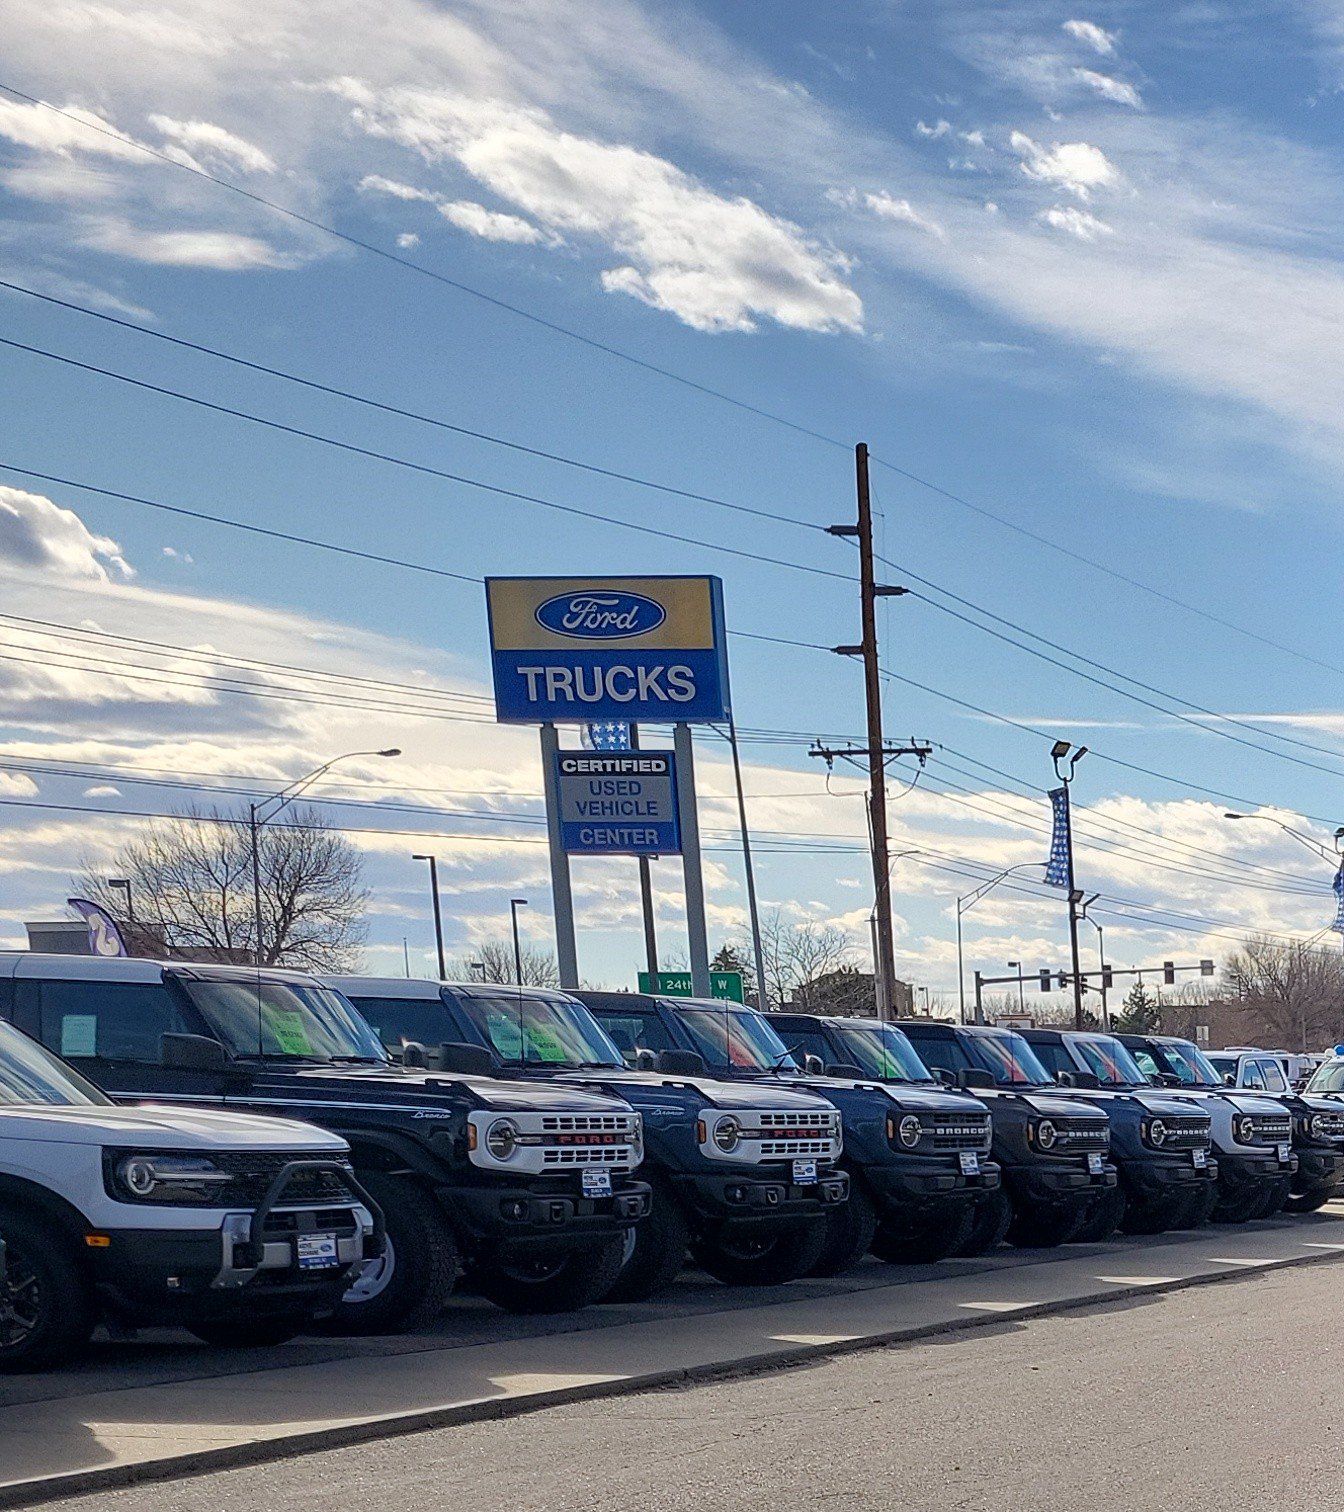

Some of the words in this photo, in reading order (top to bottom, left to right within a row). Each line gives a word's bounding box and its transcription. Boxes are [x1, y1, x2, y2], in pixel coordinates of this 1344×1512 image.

[562, 597, 639, 629] Ford
[517, 665, 697, 702] TRUCKS
[562, 759, 667, 773] CERTIFIED
[589, 780, 642, 796] USED
[576, 801, 659, 817] VEHICLE
[579, 828, 660, 846] CENTER
